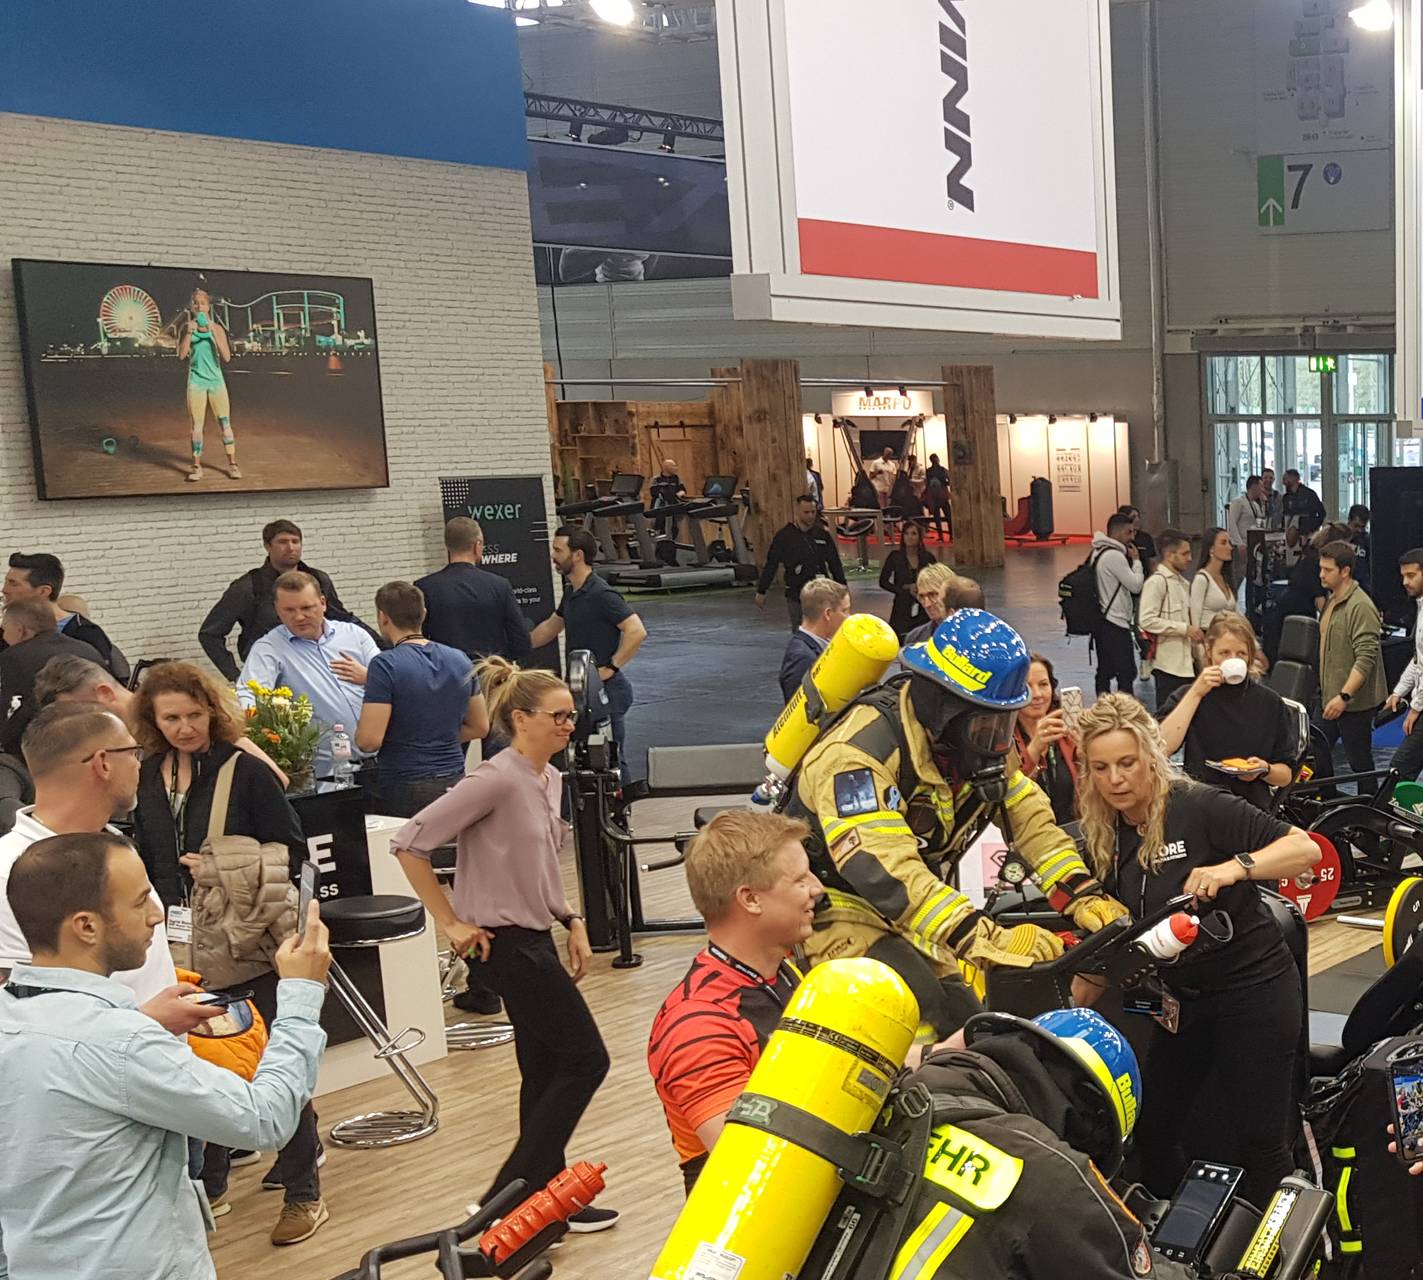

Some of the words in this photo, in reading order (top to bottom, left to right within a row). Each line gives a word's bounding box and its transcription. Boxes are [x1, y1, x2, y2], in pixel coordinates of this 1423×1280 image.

[1287, 164, 1314, 209] 7
[467, 504, 522, 520] wexer
[942, 643, 993, 684] Bullard
[1154, 840, 1187, 859] ORE
[1320, 867, 1335, 882] 25
